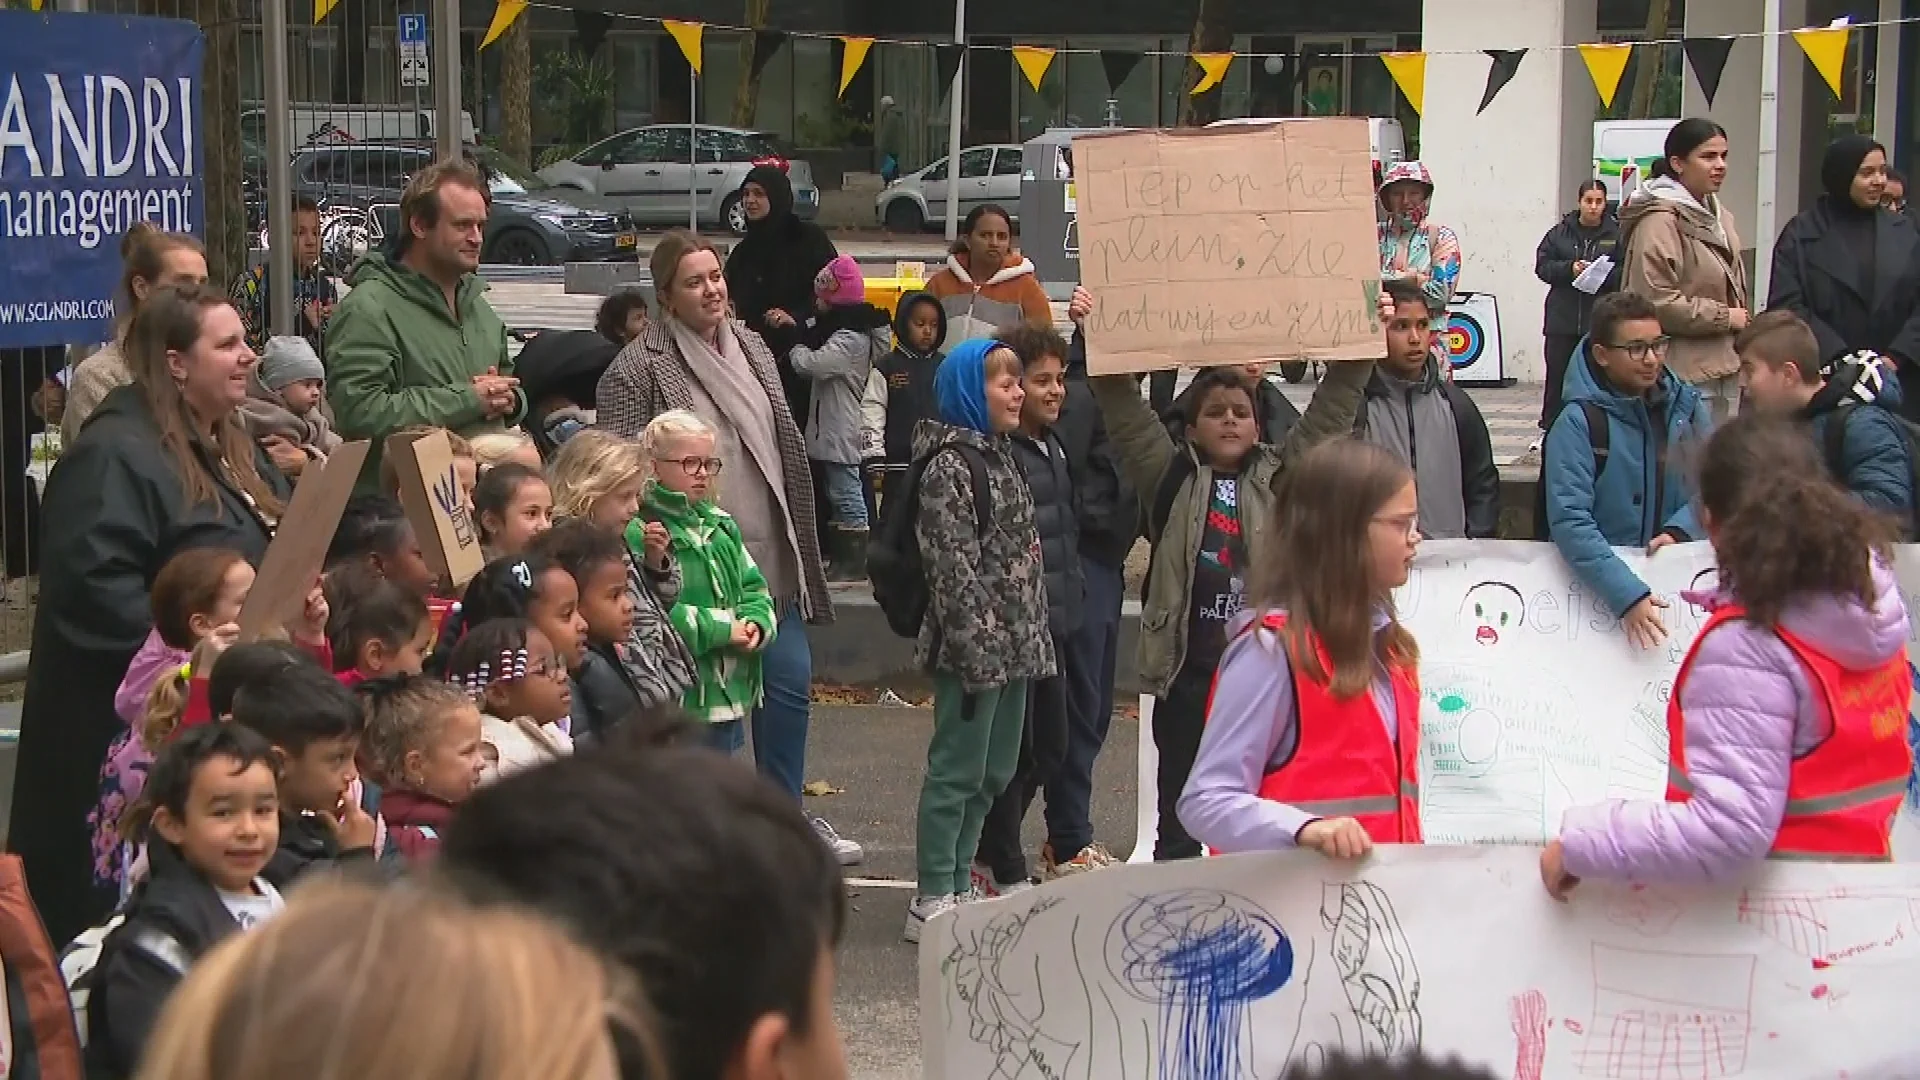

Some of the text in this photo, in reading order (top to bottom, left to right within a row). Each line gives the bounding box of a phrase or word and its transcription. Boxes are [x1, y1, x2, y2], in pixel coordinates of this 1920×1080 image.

[404, 17, 419, 39] P
[1275, 160, 1354, 206] het
[1089, 294, 1155, 334] dat
